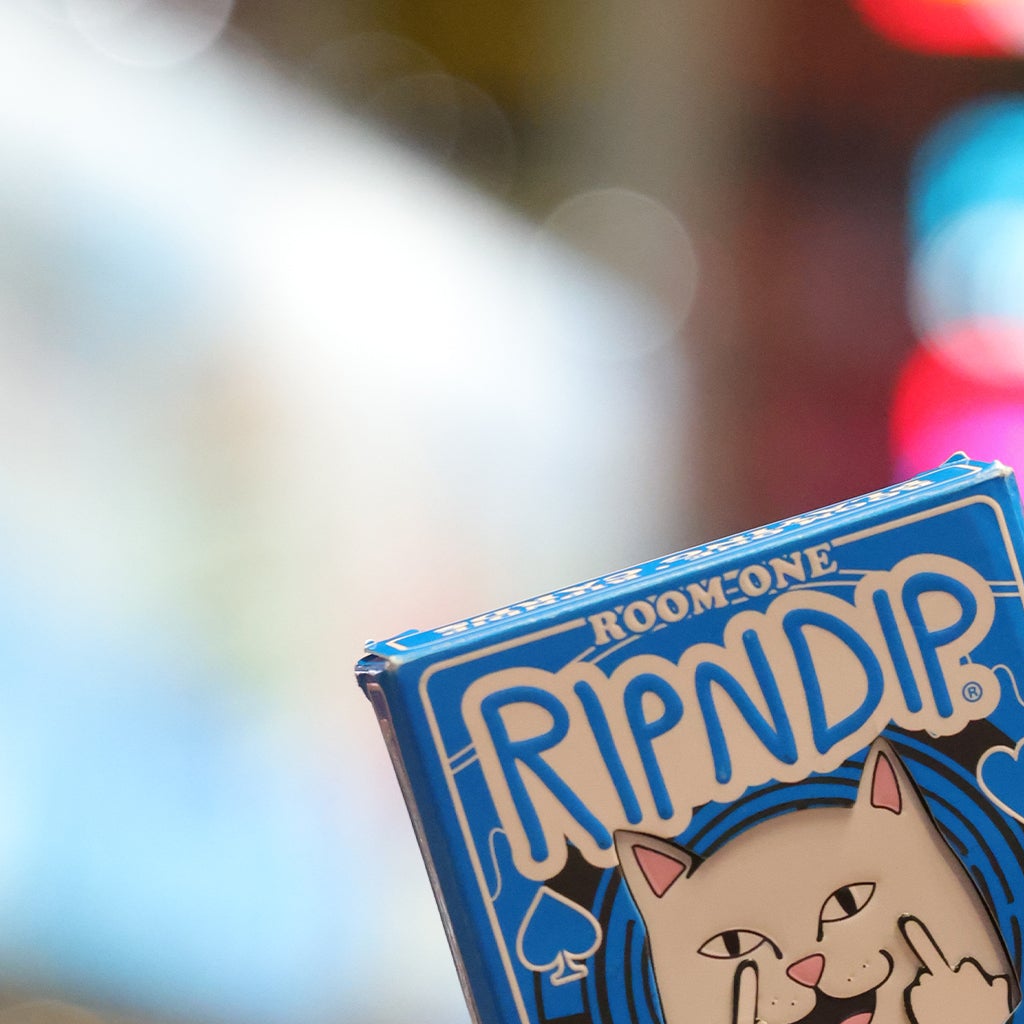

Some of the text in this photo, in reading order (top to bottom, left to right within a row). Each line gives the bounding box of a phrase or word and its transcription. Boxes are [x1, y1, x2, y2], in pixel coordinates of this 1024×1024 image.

[588, 575, 729, 647] ROOM
[738, 541, 838, 599] ONE
[478, 569, 980, 865] RIPNDIP
